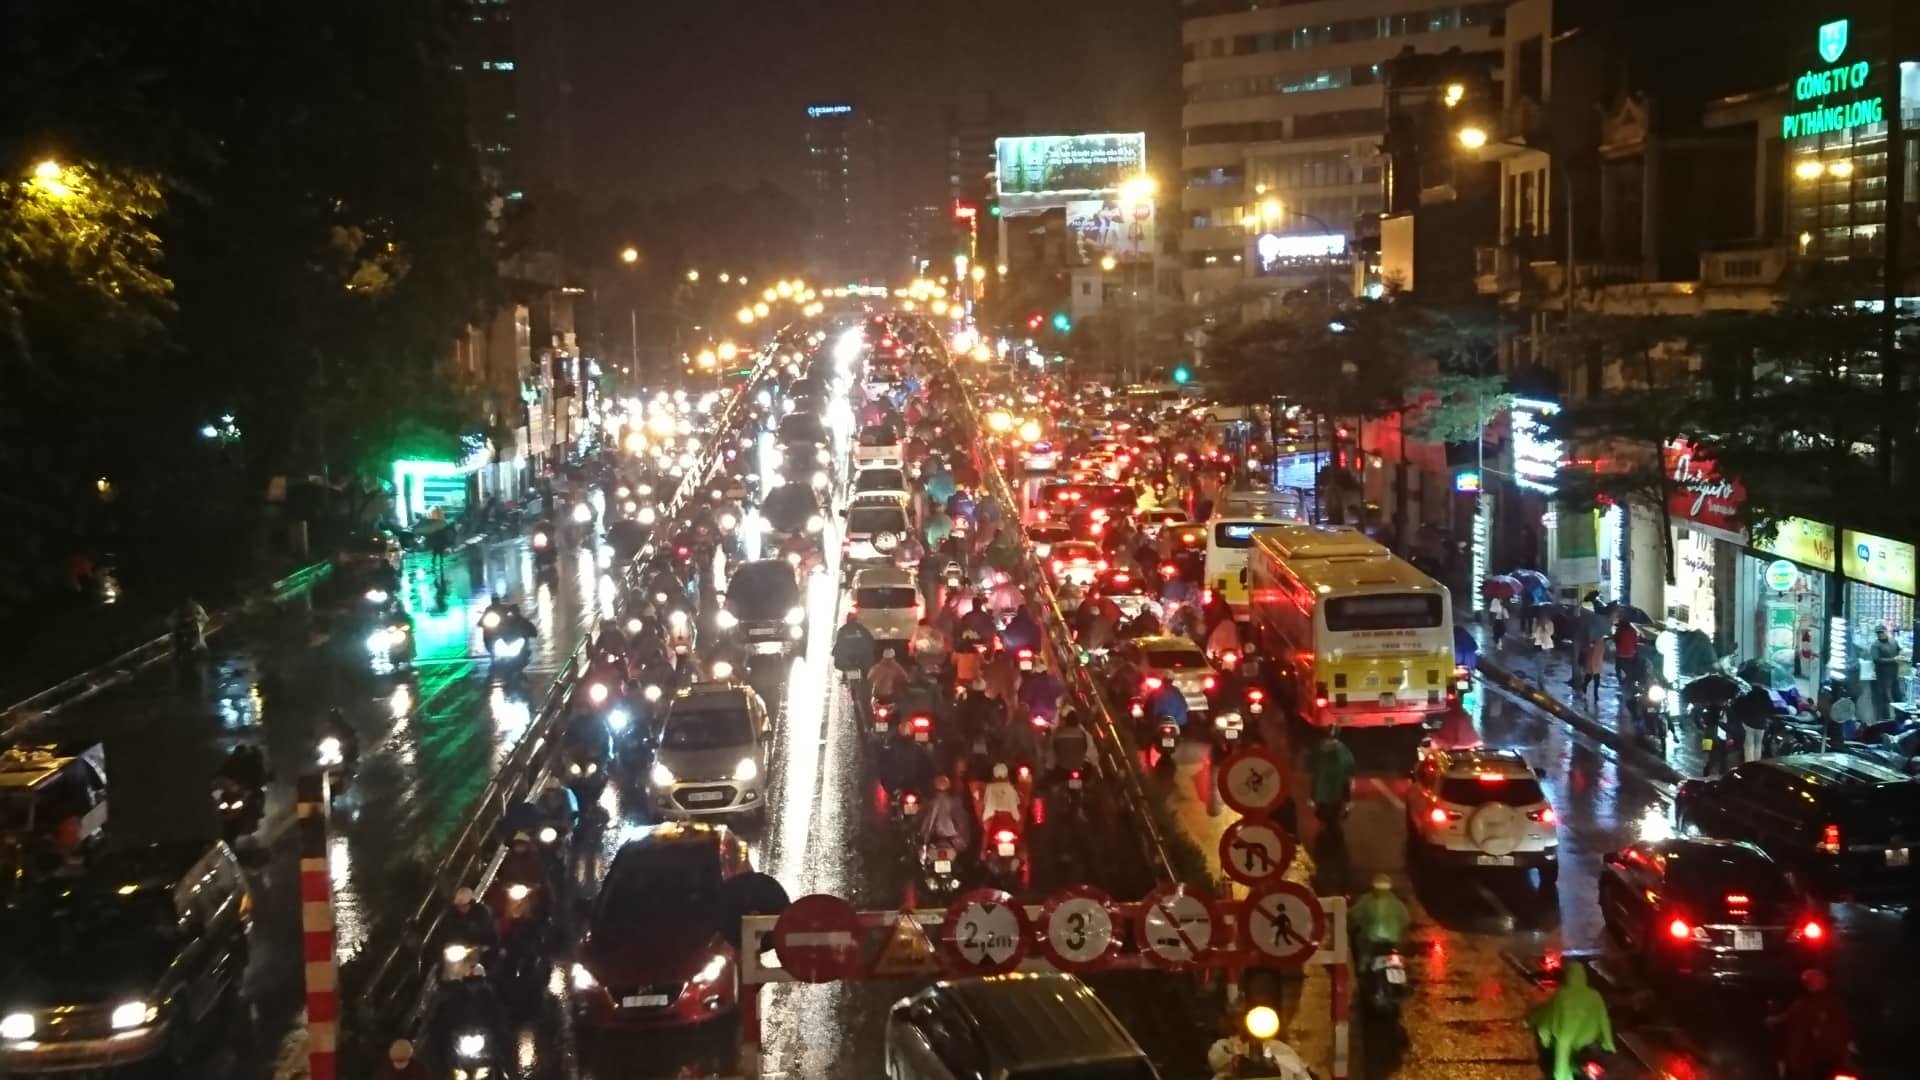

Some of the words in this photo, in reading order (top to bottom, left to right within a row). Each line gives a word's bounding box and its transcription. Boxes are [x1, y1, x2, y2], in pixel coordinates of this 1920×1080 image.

[1797, 70, 1831, 101] CÔNG
[1832, 66, 1850, 93] TY
[1851, 61, 1869, 89] CP
[1783, 114, 1800, 139] PV
[1800, 104, 1844, 136] THĂNG
[1845, 97, 1882, 128] LONG
[963, 921, 1012, 953] 2,2m
